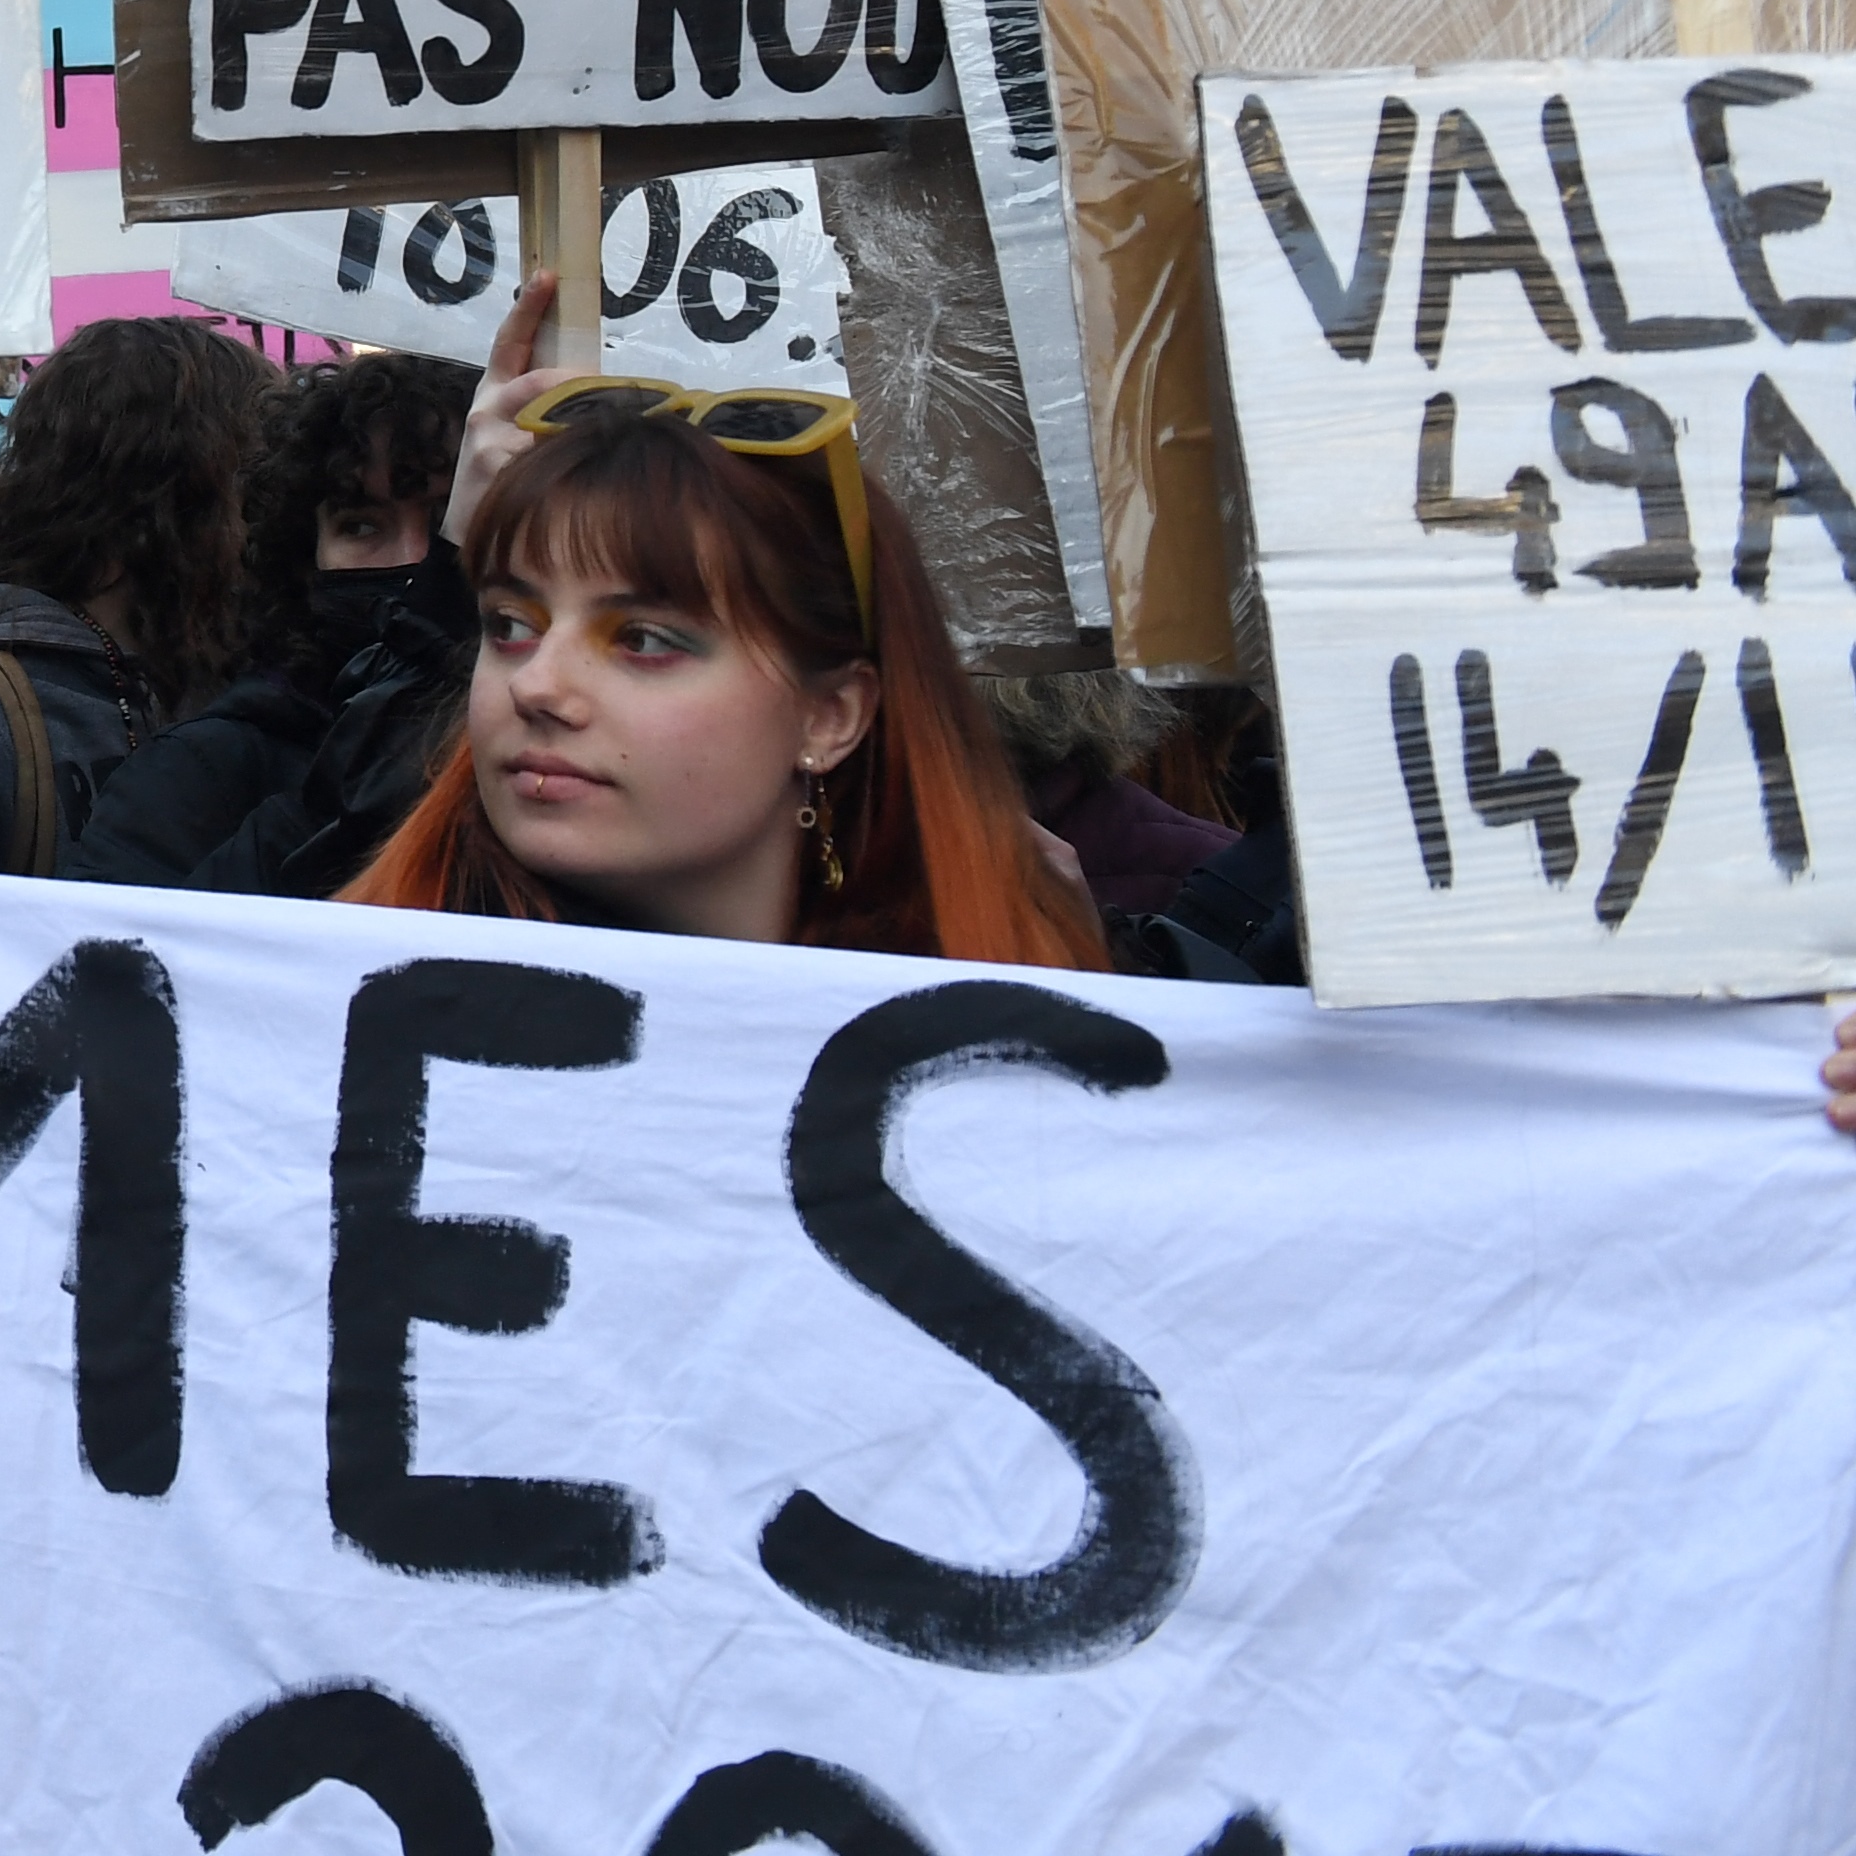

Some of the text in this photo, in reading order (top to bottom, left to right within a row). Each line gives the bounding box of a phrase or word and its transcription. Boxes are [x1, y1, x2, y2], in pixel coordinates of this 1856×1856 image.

[1232, 68, 1856, 370] VALE
[1730, 371, 1856, 602] A
[1389, 634, 1856, 937] 14/1
